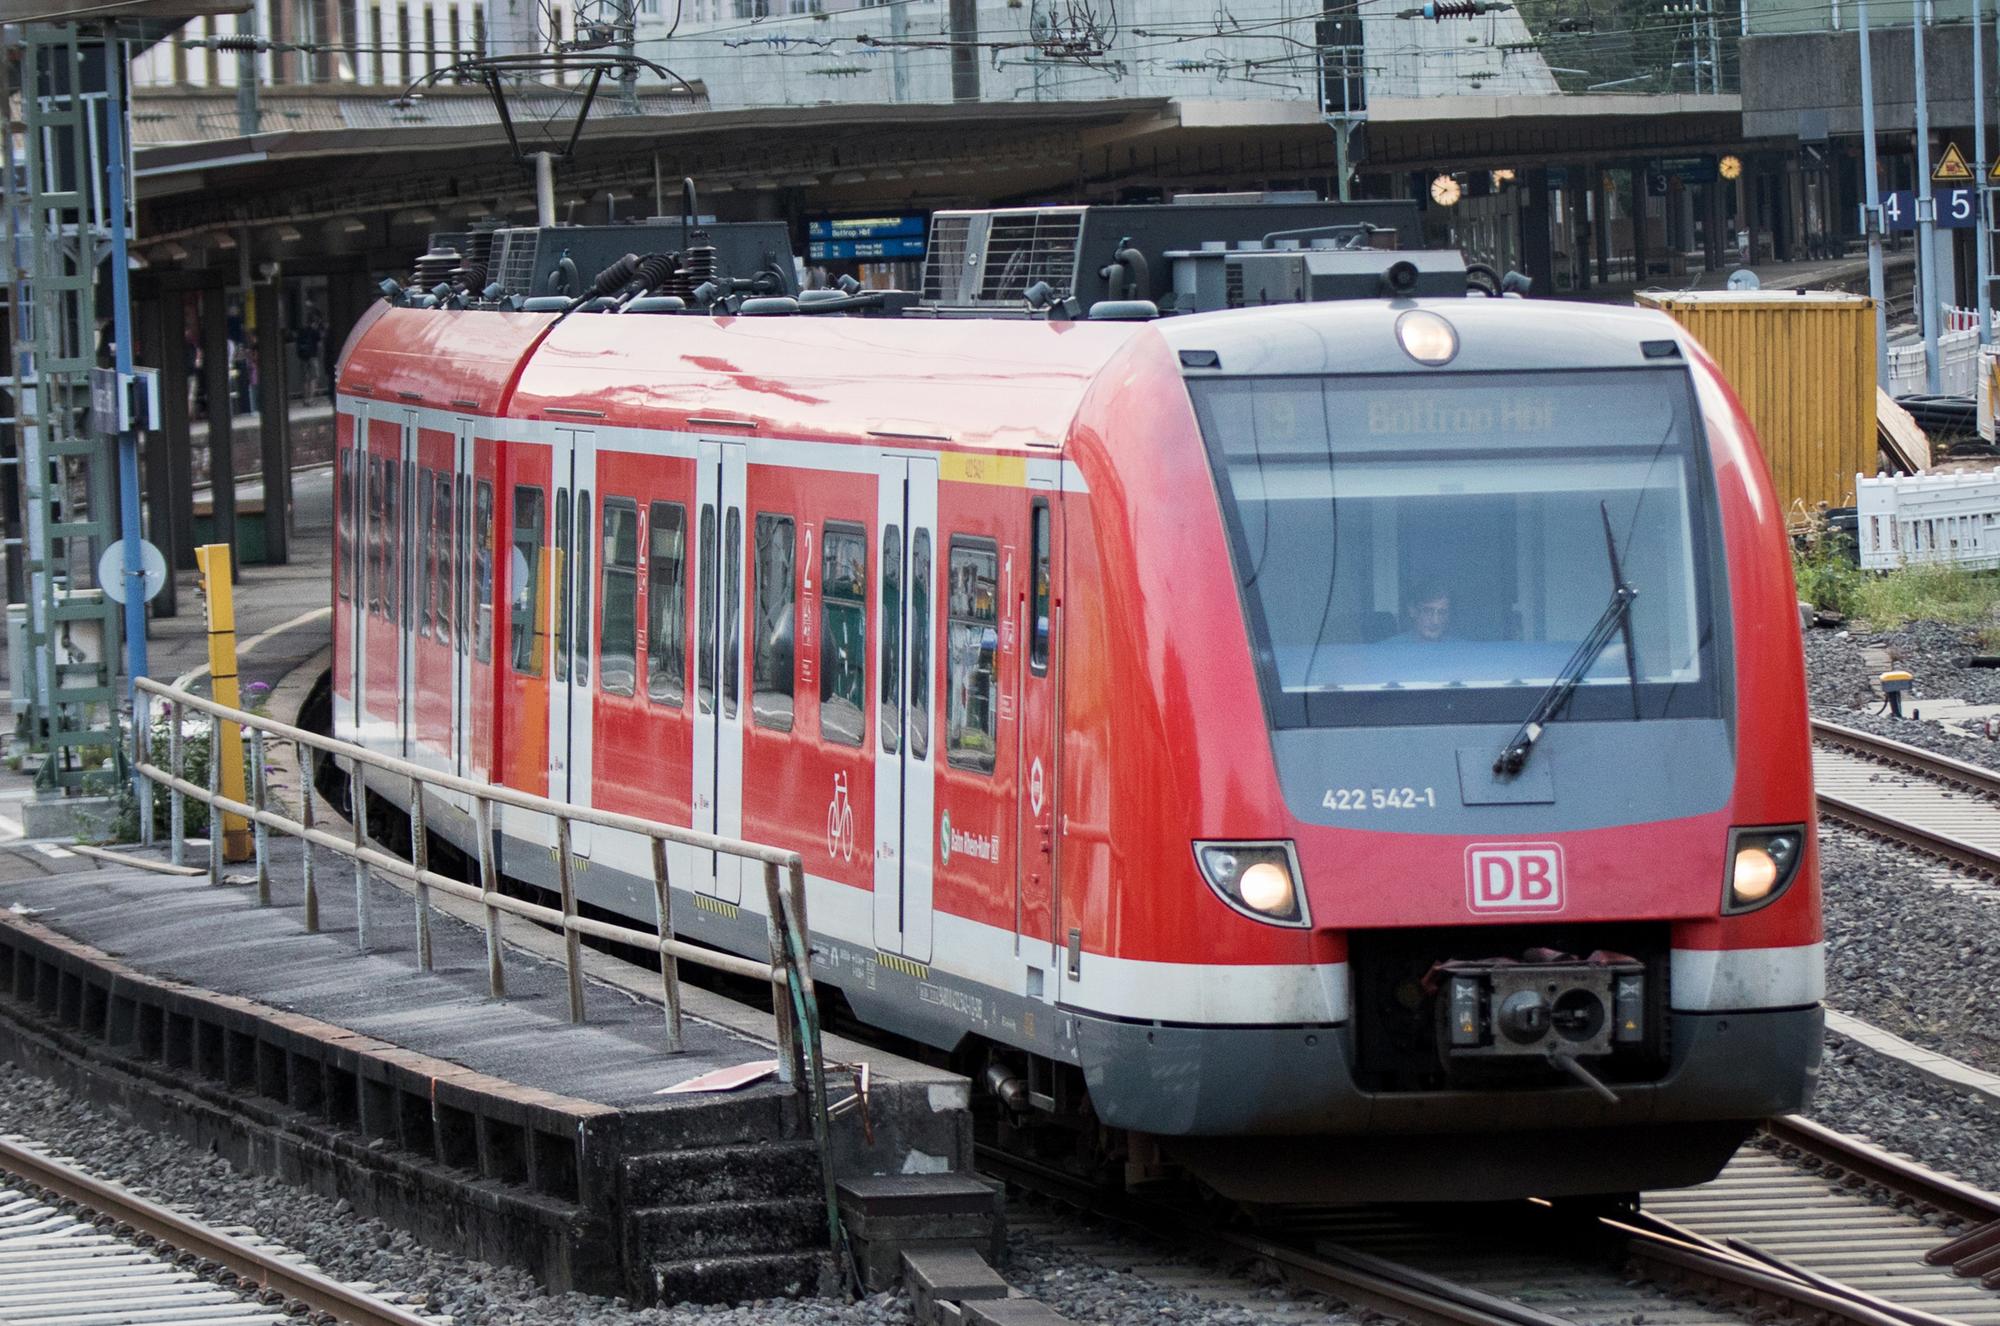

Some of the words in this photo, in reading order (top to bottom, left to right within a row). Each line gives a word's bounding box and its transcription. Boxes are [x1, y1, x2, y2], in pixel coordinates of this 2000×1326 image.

[1656, 175, 1667, 192] 3
[1887, 192, 1900, 221] 4
[1951, 189, 1970, 219] 5
[1368, 398, 1493, 435] Bottrop
[1501, 397, 1556, 432] Hbf
[639, 510, 646, 564] 2
[804, 529, 812, 589] 2
[1004, 552, 1012, 618] 1
[1322, 789, 1366, 810] 422
[1372, 787, 1436, 809] 542-1
[1479, 855, 1553, 902] DB
